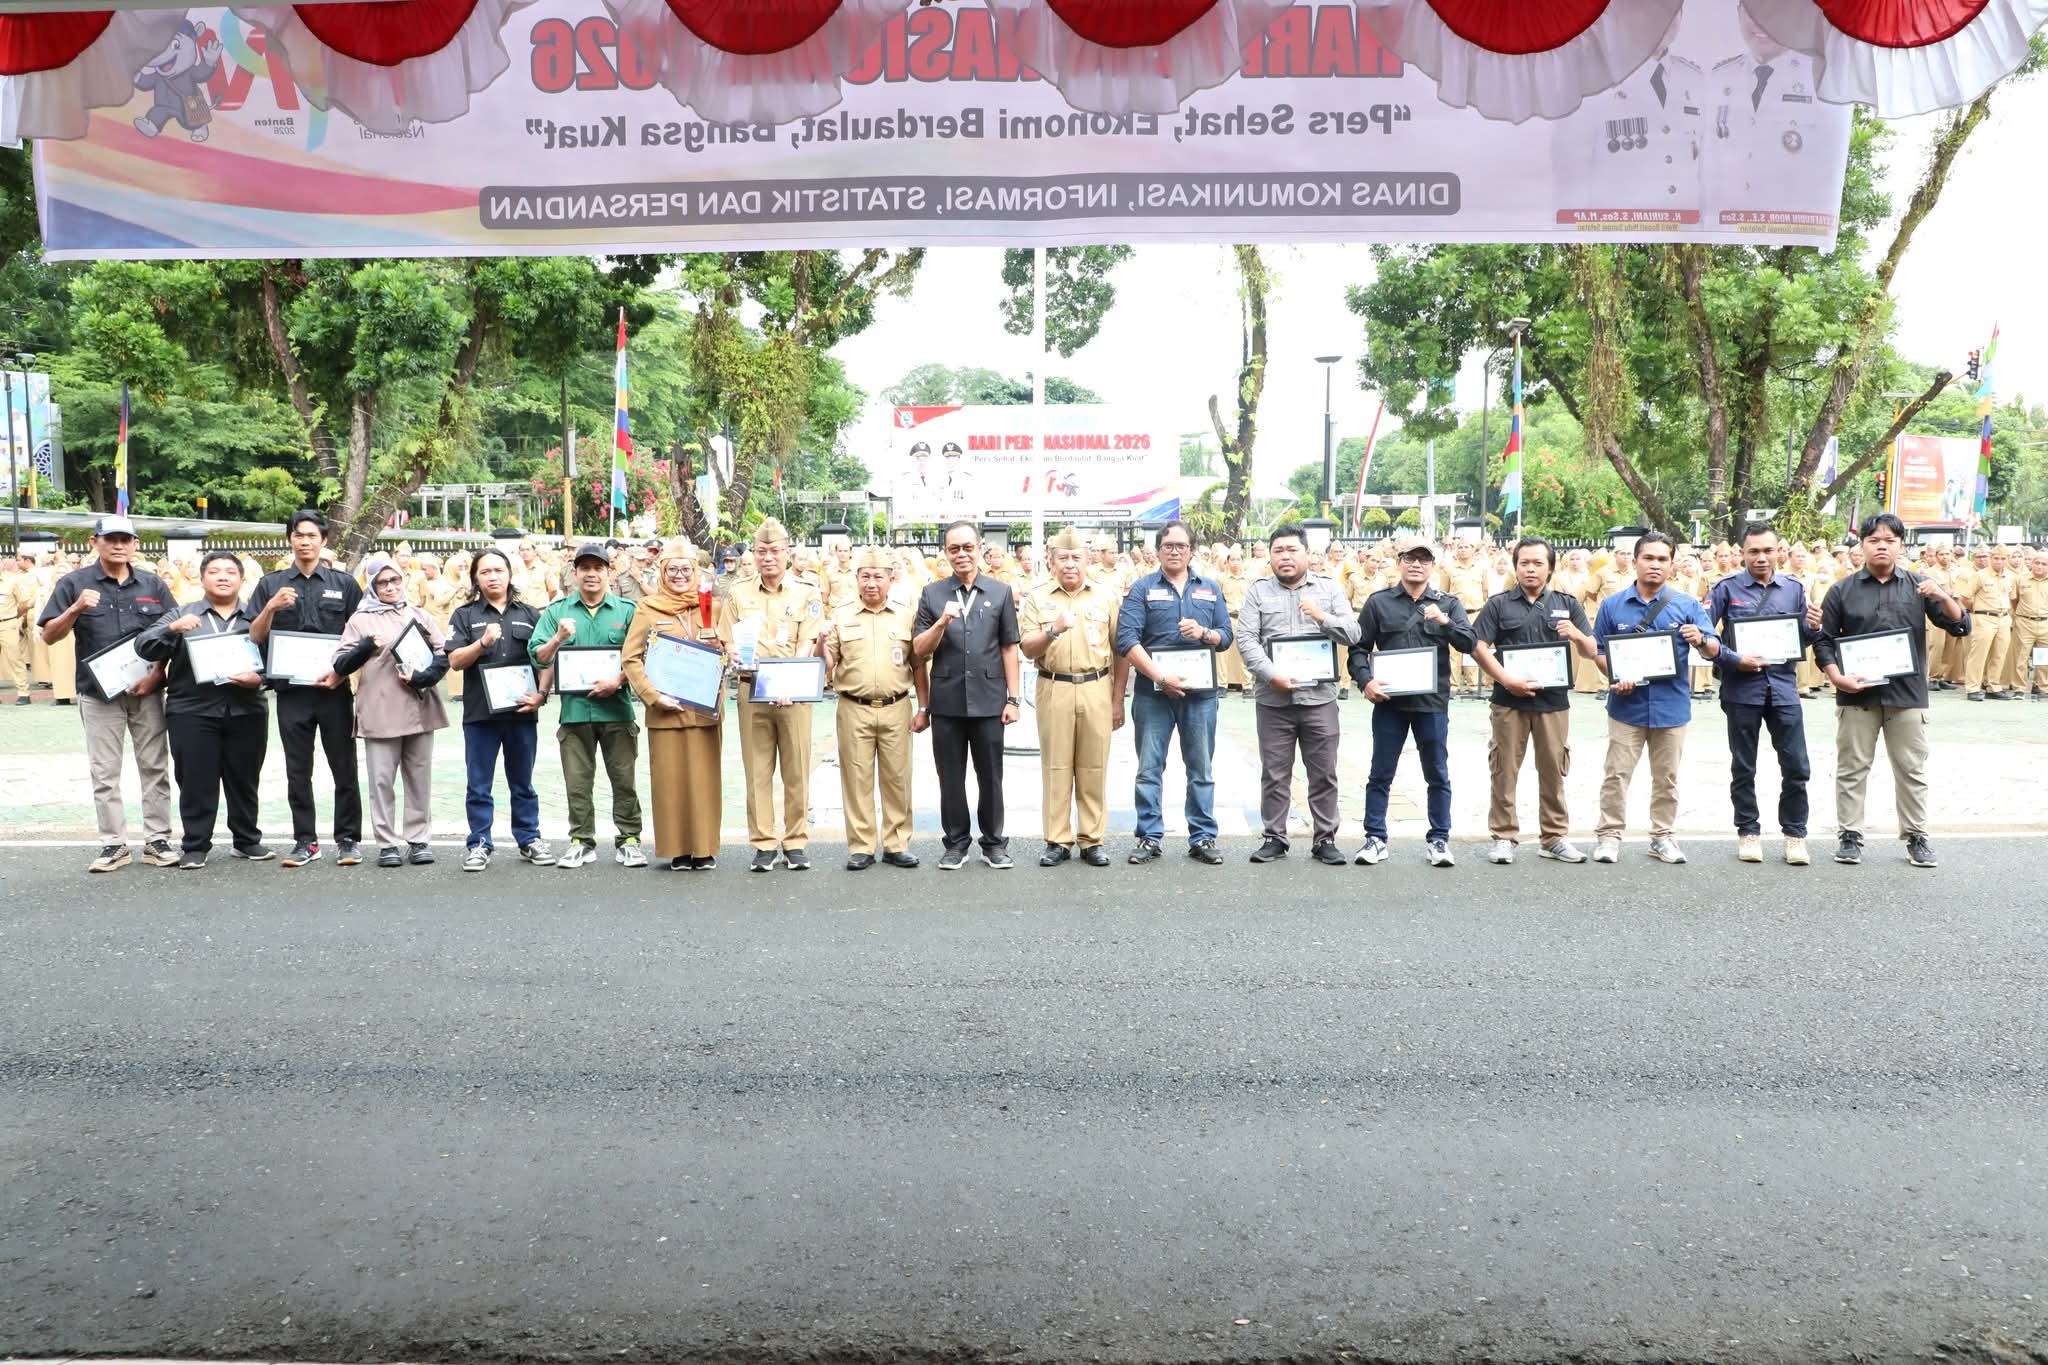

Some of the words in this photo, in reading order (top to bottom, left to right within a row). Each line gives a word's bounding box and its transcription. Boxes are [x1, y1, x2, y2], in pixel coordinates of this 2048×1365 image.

[968, 435, 1001, 450] HARI
[1043, 434, 1110, 450] NASIONAL
[1114, 434, 1151, 450] 2026
